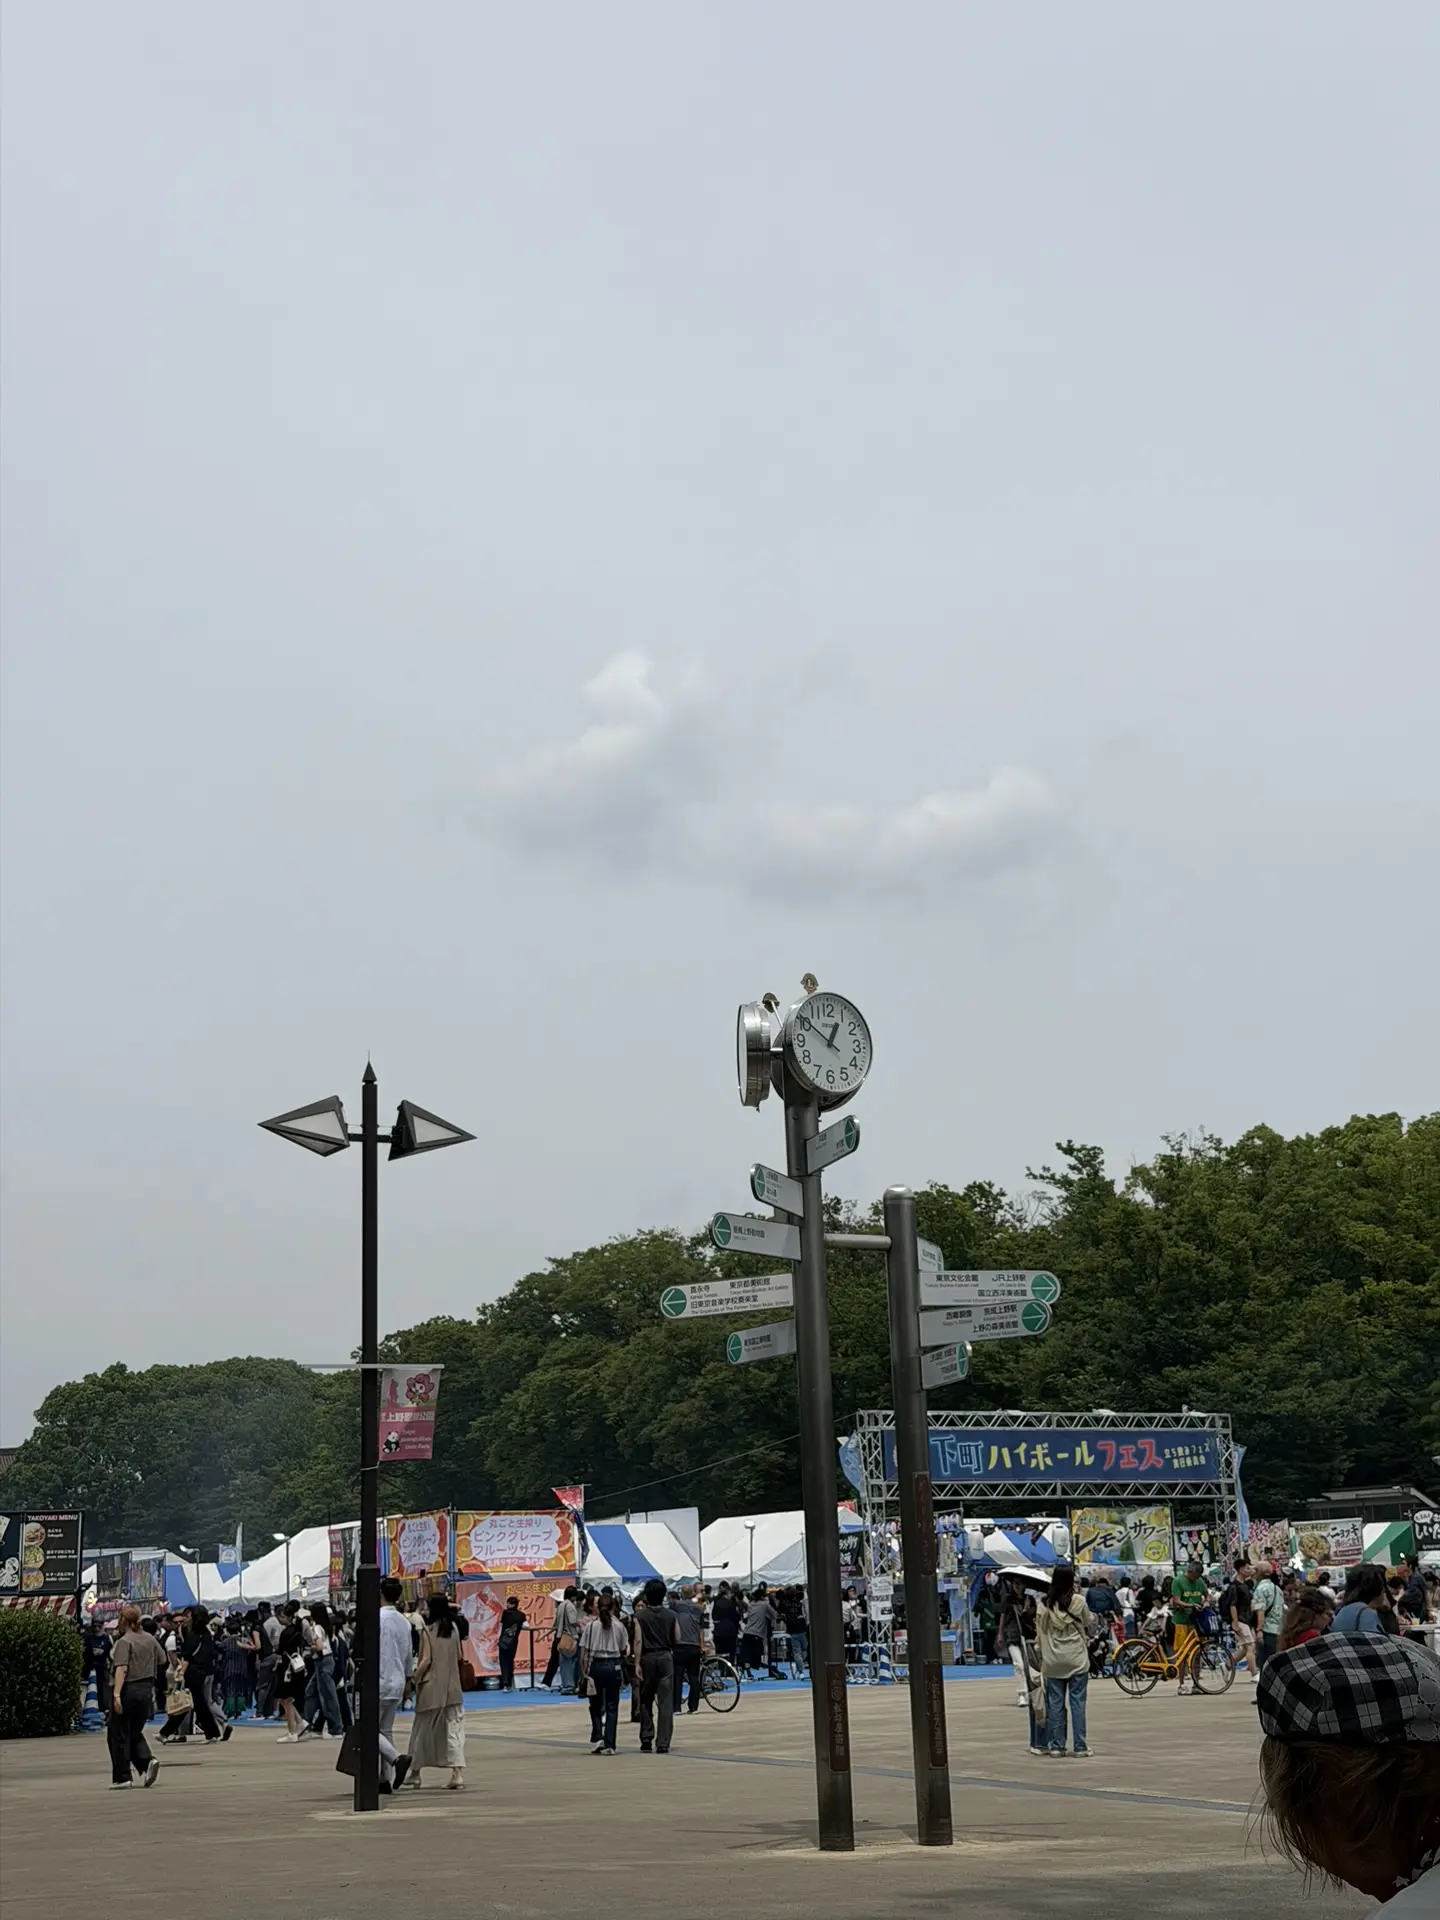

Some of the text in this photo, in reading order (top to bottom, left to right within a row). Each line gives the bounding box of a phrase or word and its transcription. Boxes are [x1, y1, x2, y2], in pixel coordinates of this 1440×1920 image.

[810, 1004, 820, 1020] 11
[822, 1003, 834, 1018] 12
[800, 1016, 812, 1031] 10
[848, 1022, 857, 1036] 2
[796, 1033, 806, 1048] 9
[852, 1039, 862, 1054] 3
[802, 1050, 812, 1064] 8
[849, 1056, 858, 1070] 4
[814, 1064, 822, 1078] 7
[826, 1070, 835, 1084] 6
[840, 1067, 849, 1081] 5
[730, 1278, 770, 1289] 東京都美術館
[936, 1274, 978, 1282] 東京文化会館
[992, 1274, 1026, 1282] JR上野駅
[690, 1284, 710, 1294] 寛永寺
[984, 1304, 1017, 1316] 京成上野駅
[972, 1321, 1018, 1333] 上野の森美術館
[474, 1529, 552, 1543] ピンクグレープ
[1074, 1519, 1166, 1555] レモンサワー
[474, 1545, 552, 1556] フルーツサワー
